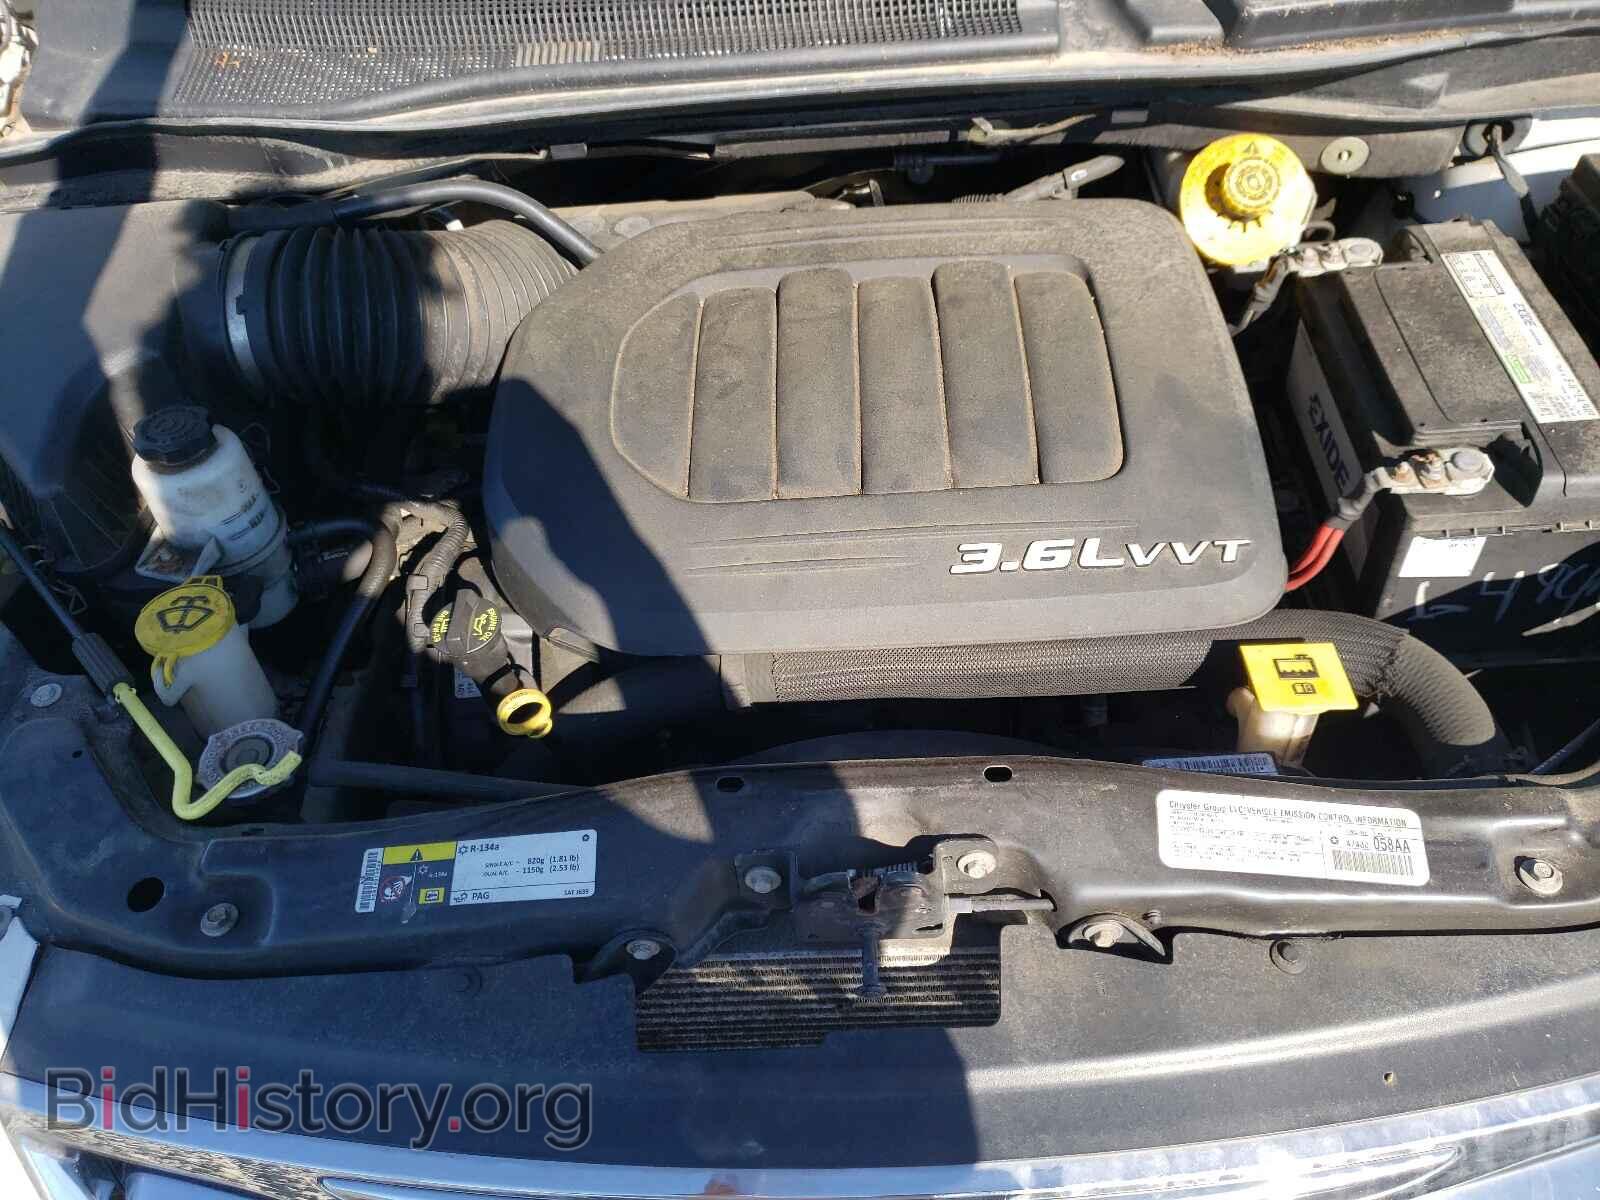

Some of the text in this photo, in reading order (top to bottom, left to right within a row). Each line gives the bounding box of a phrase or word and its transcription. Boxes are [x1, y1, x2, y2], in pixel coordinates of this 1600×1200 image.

[1308, 394, 1350, 491] EXIDE
[950, 538, 1252, 575] 3.6L VVT
[479, 607, 499, 641] ENGINE OIL
[1169, 800, 1201, 810] Chrysler
[1203, 803, 1226, 813] Group
[1279, 809, 1316, 820] EMISSION
[1318, 812, 1353, 823] CONTROL
[1354, 815, 1408, 827] INFORMATION
[470, 843, 500, 853] R-134a
[1373, 837, 1412, 854] 058AA
[527, 857, 545, 866] 820g
[549, 854, 568, 864] (1.81
[569, 853, 579, 863] lb)
[523, 866, 544, 875] 1150g
[549, 864, 568, 873] (2.53
[569, 863, 580, 872] lb)
[472, 891, 490, 900] PAG
